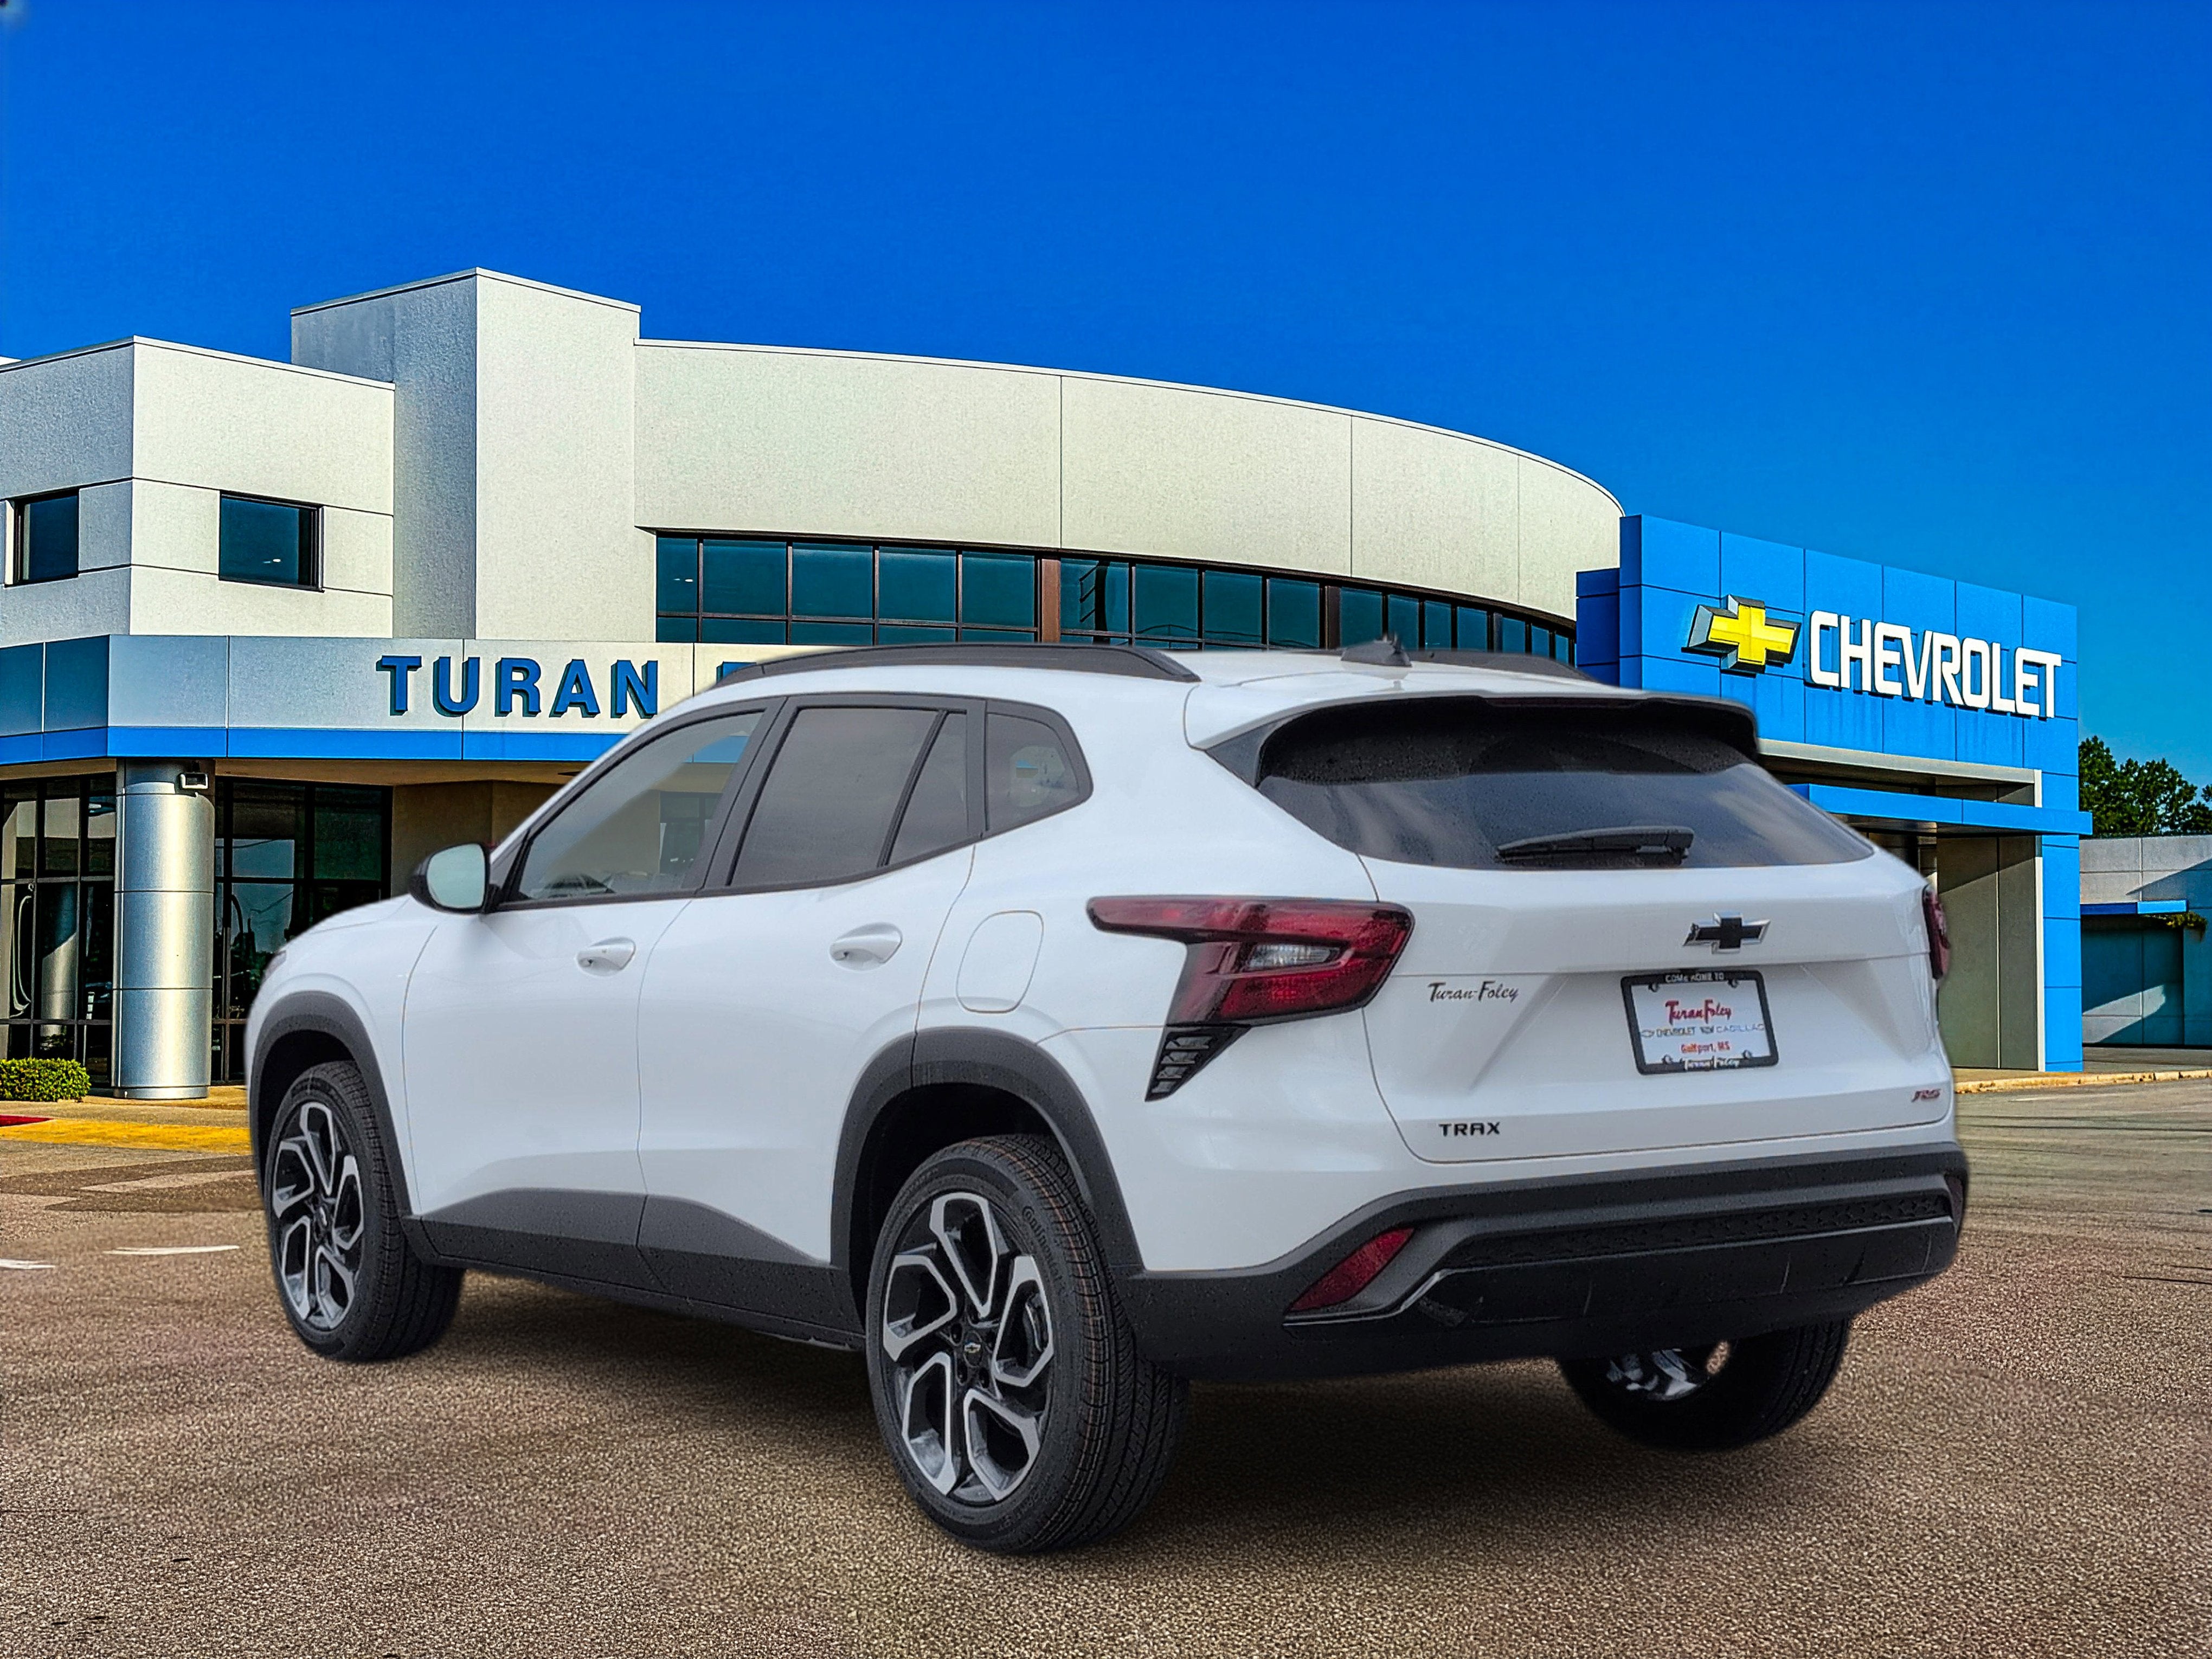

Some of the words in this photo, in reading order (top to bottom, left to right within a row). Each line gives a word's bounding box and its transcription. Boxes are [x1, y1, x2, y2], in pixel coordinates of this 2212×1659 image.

[1809, 610, 2062, 718] CHEVROLET
[376, 655, 658, 719] TURAN
[1716, 1023, 1765, 1034] CADILLAC
[1911, 1088, 1942, 1103] RS
[1438, 1121, 1500, 1137] TRAX
